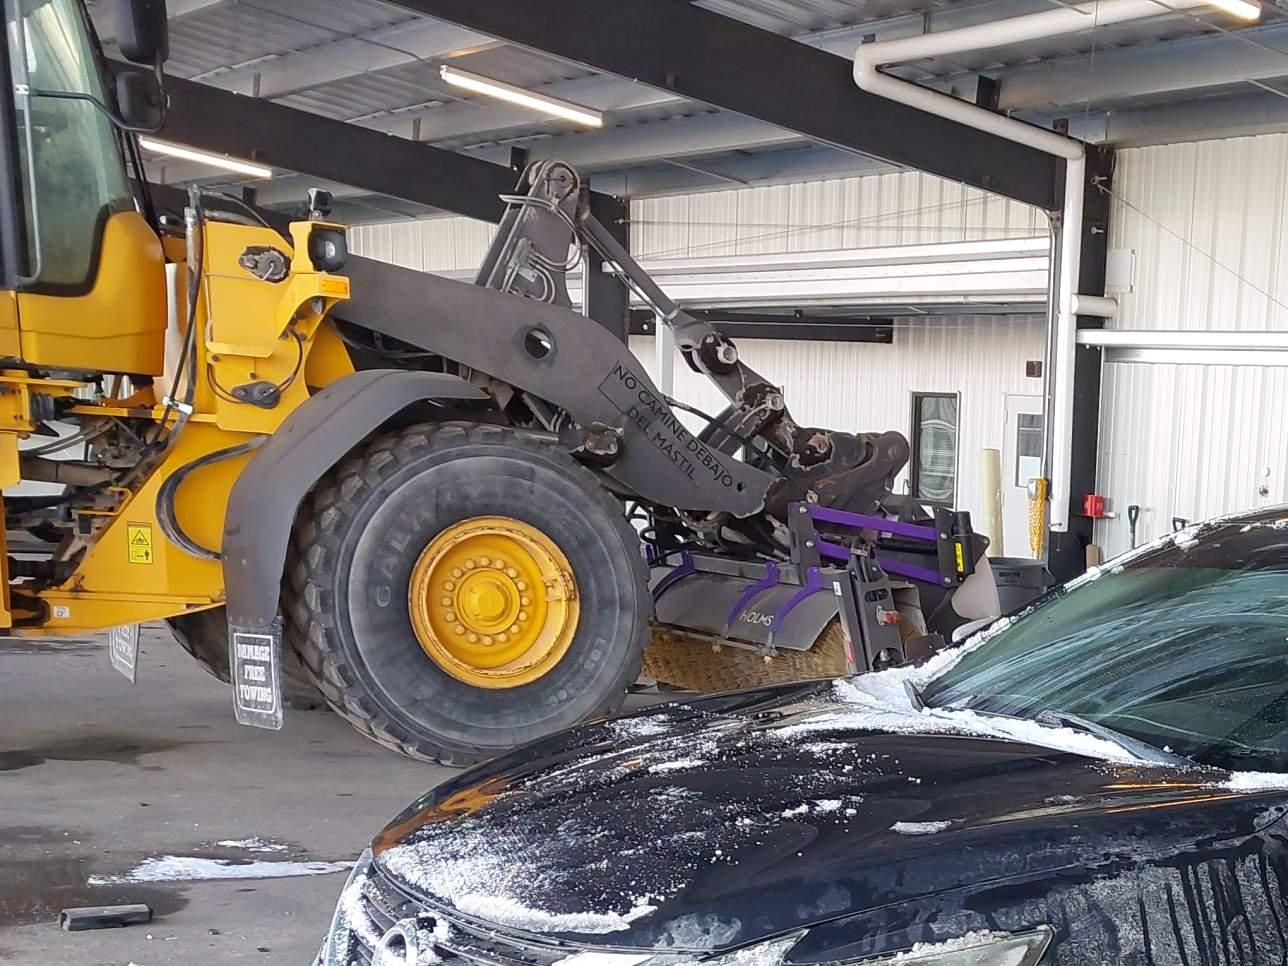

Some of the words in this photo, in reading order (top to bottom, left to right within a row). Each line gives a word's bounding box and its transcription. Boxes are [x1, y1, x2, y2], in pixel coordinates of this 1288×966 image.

[613, 365, 637, 390] NO
[638, 390, 687, 440] CAMINE
[686, 439, 733, 488] DEBAJO
[627, 406, 653, 435] DEL
[738, 609, 774, 627] HOLMS
[237, 644, 270, 662] DAMAGE
[244, 664, 266, 682] FREE
[240, 685, 272, 703] TOWING
